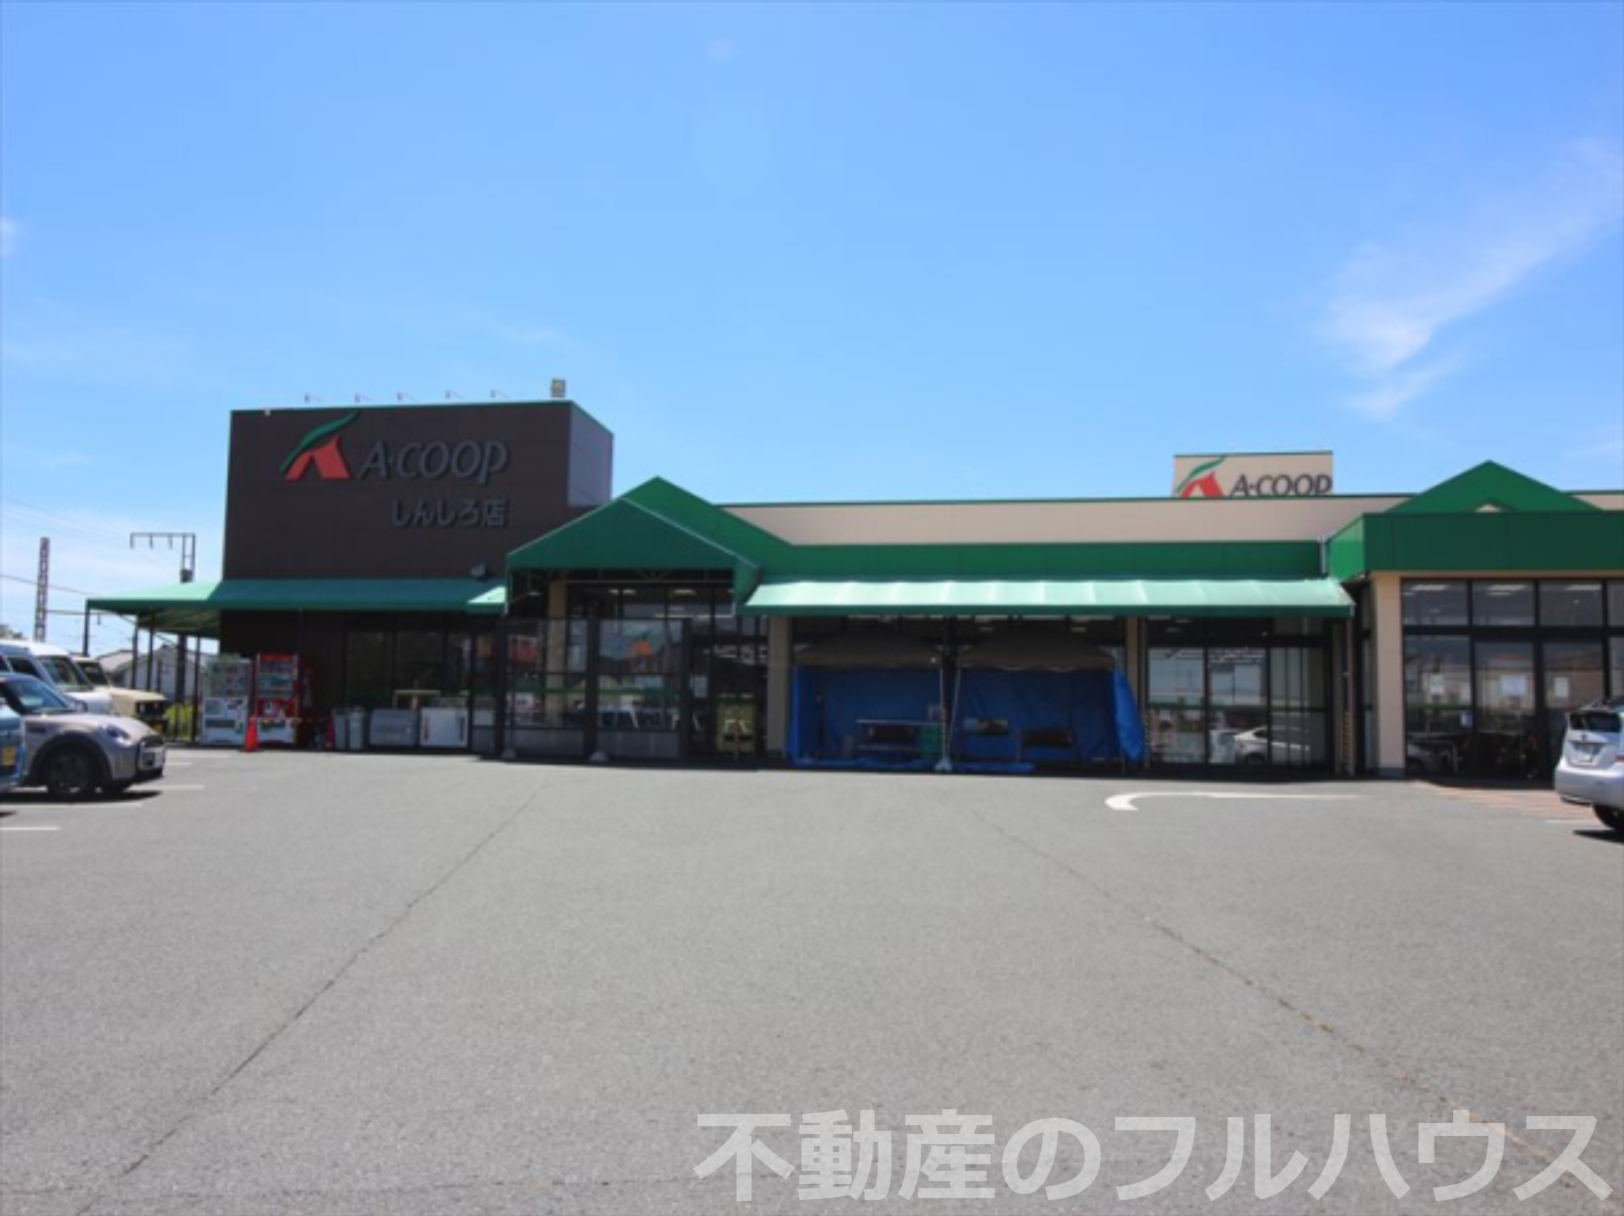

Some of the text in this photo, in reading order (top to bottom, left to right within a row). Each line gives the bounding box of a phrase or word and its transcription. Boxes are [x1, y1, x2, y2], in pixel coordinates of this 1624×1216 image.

[391, 499, 507, 527] しんしろ店
